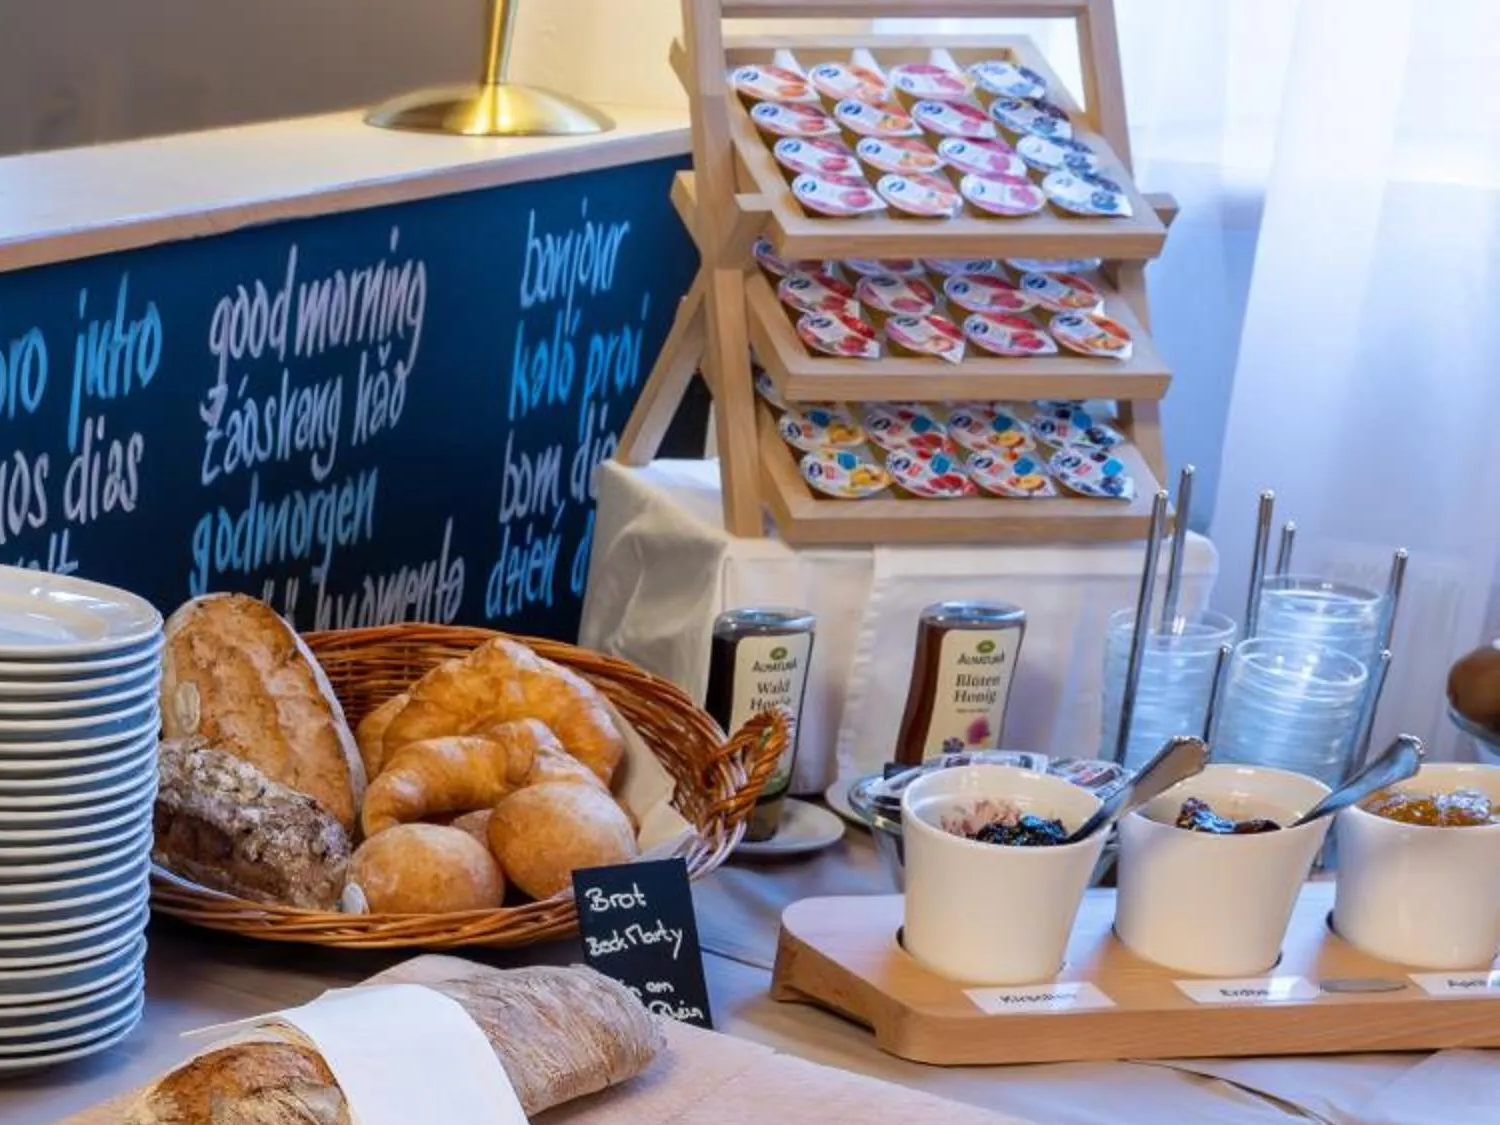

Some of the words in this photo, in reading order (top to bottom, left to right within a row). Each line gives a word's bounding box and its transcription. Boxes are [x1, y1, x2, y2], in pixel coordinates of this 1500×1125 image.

[520, 196, 630, 335] bonjour
[67, 271, 163, 454] jutro
[577, 292, 650, 444] proi
[63, 414, 145, 525] dias
[499, 428, 563, 524] bom
[584, 881, 648, 913] Brot
